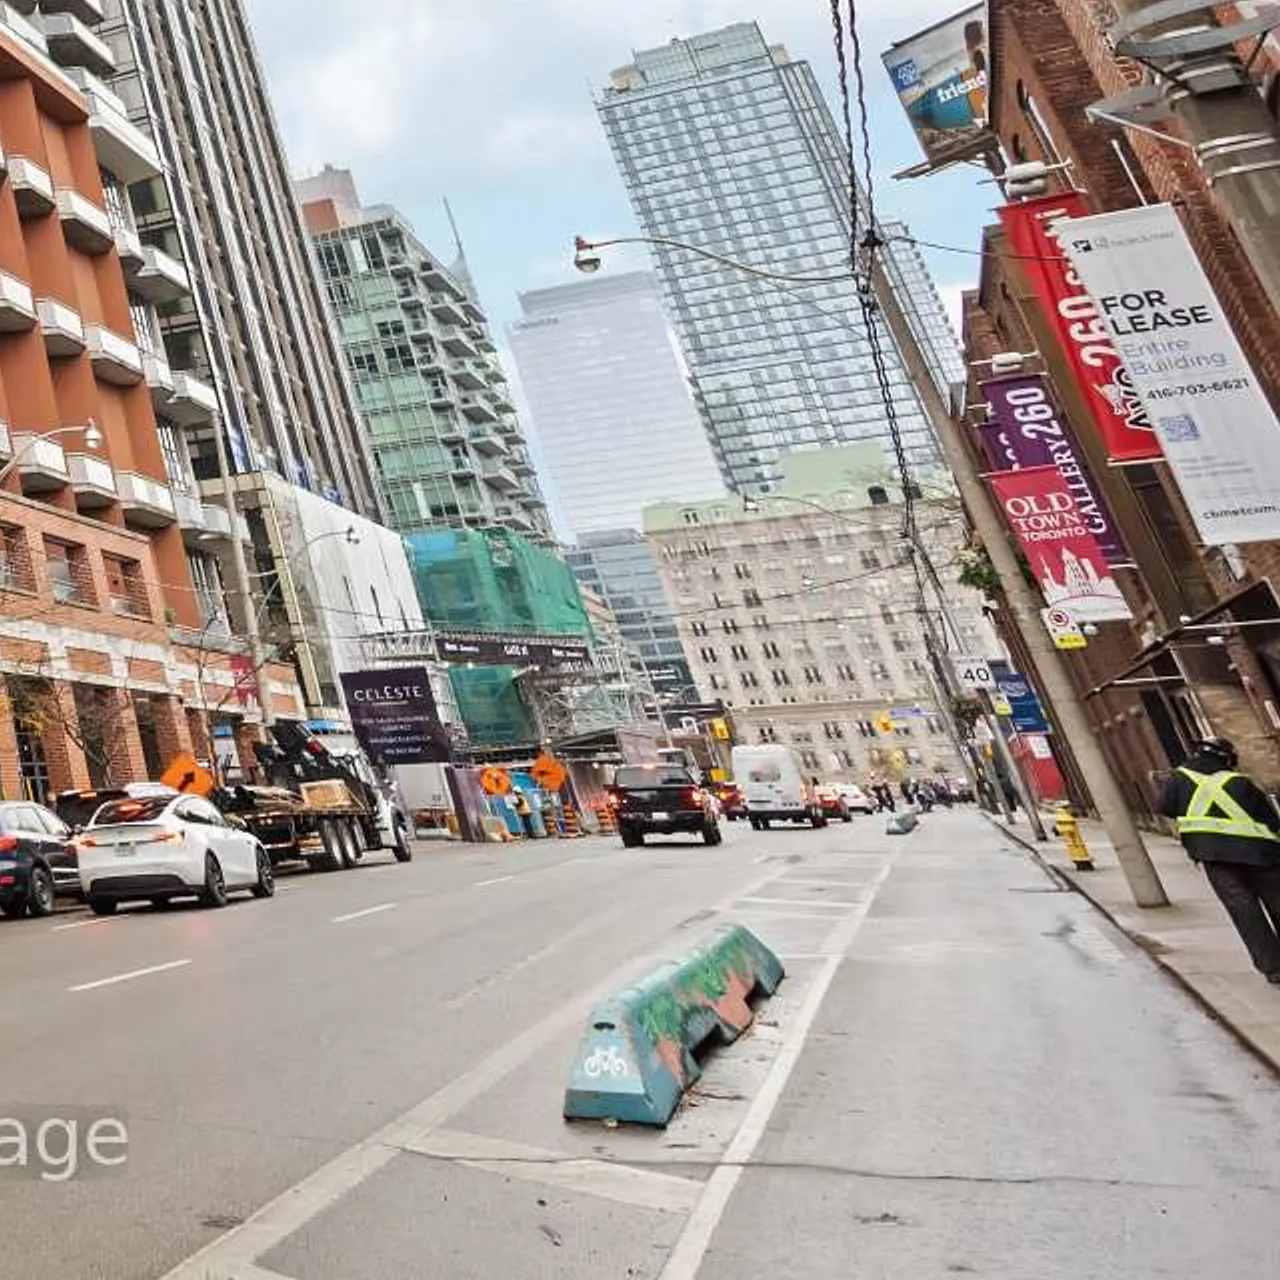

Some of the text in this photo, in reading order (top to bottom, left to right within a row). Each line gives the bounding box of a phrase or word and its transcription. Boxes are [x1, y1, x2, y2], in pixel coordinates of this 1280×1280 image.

[1100, 289, 1167, 315] FOR
[1110, 305, 1213, 336] LEASE
[1122, 338, 1189, 359] Entire
[1131, 351, 1228, 376] Building
[1006, 387, 1108, 535] GALLERY 260
[1006, 491, 1073, 517] OLD
[1012, 511, 1085, 532] TOWN
[1022, 526, 1089, 542] TORONTO
[963, 667, 990, 682] 40
[353, 685, 423, 702] CELESTE
